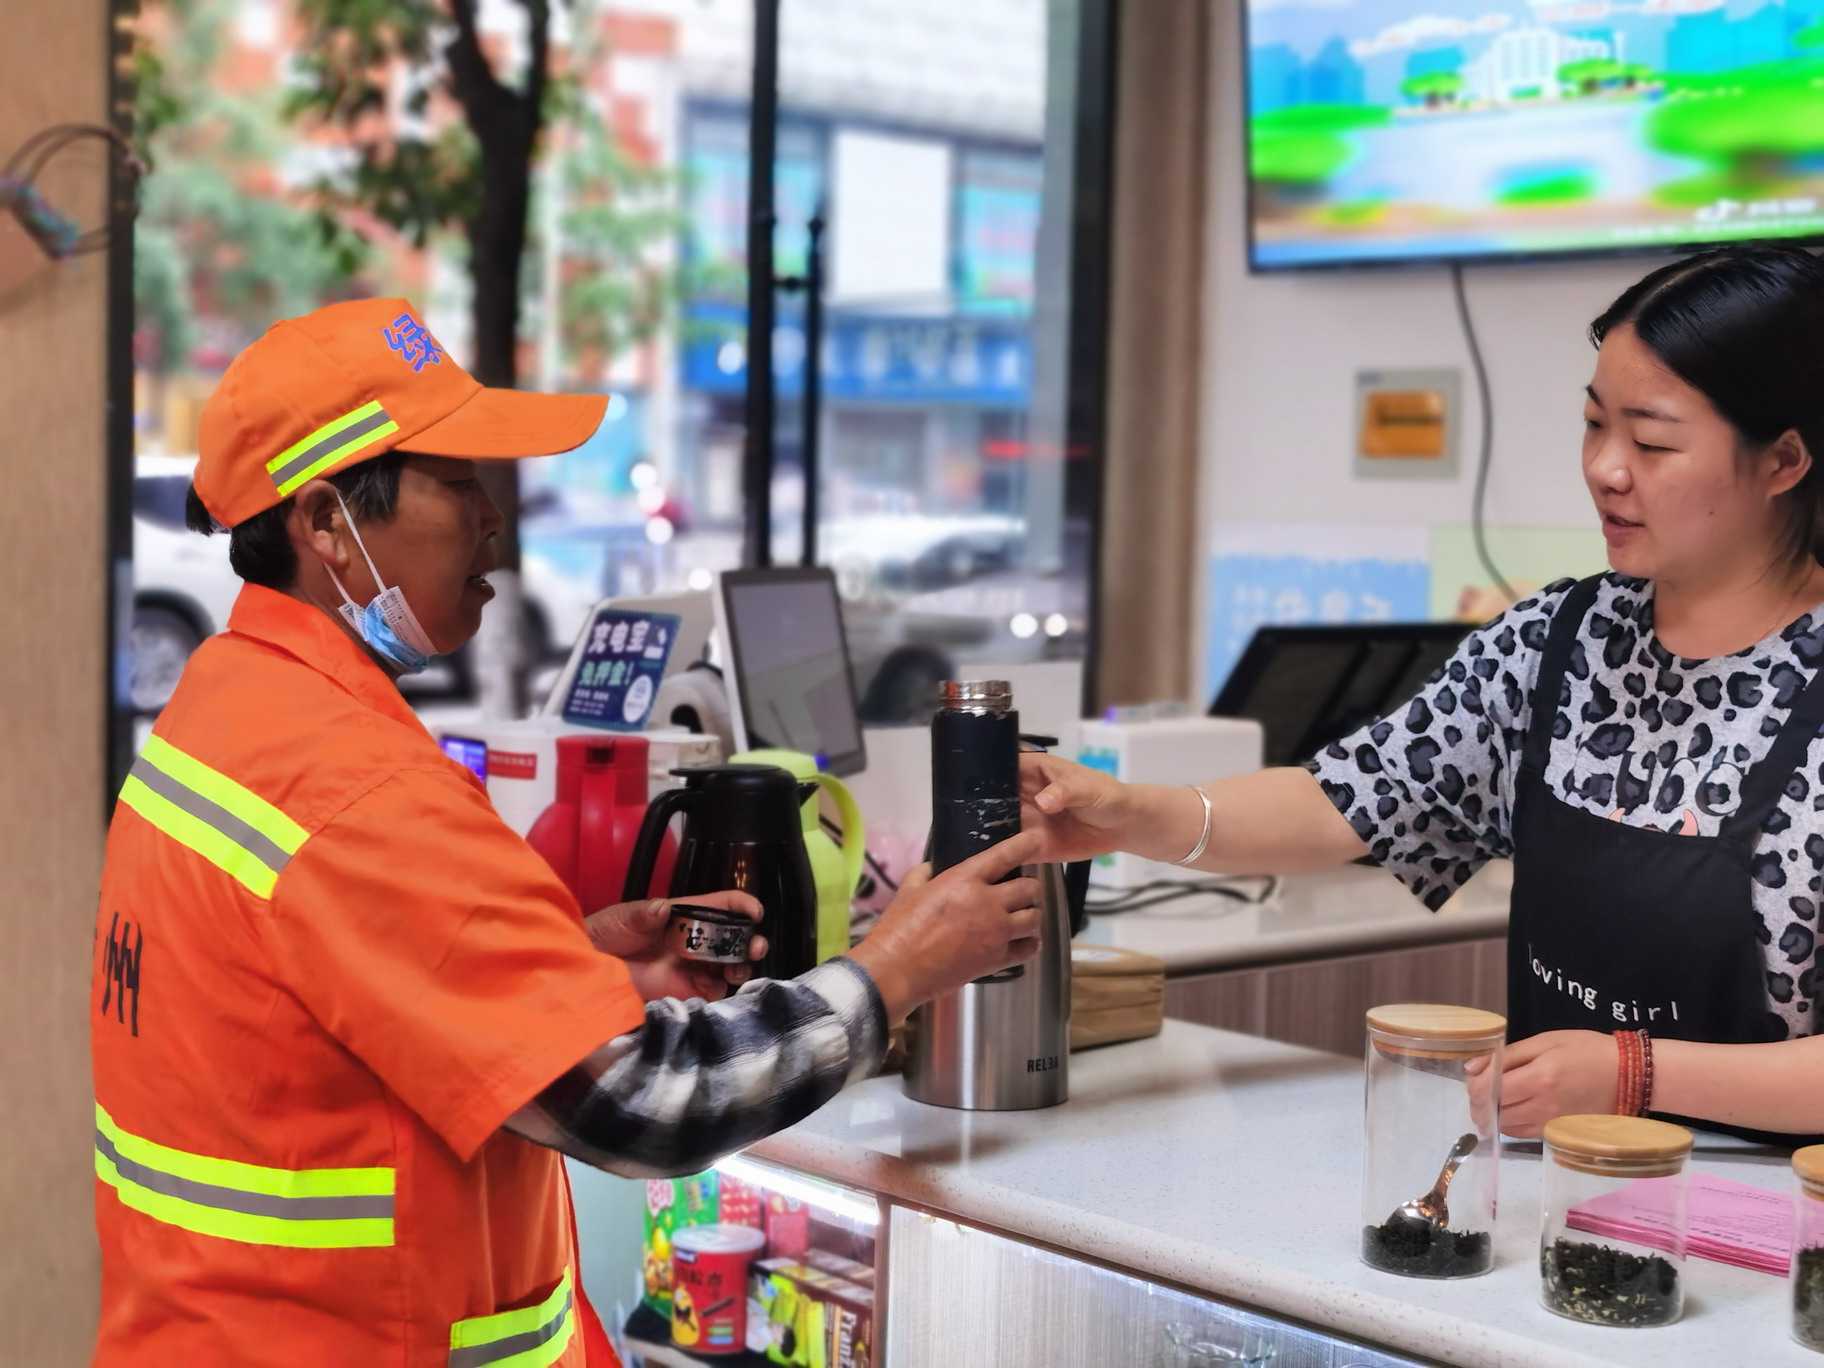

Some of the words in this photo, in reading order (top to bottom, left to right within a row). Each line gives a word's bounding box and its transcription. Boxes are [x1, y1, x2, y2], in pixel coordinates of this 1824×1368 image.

[587, 619, 651, 654] 充电宝
[1528, 943, 1598, 1010] loving
[1611, 1000, 1679, 1023] girl
